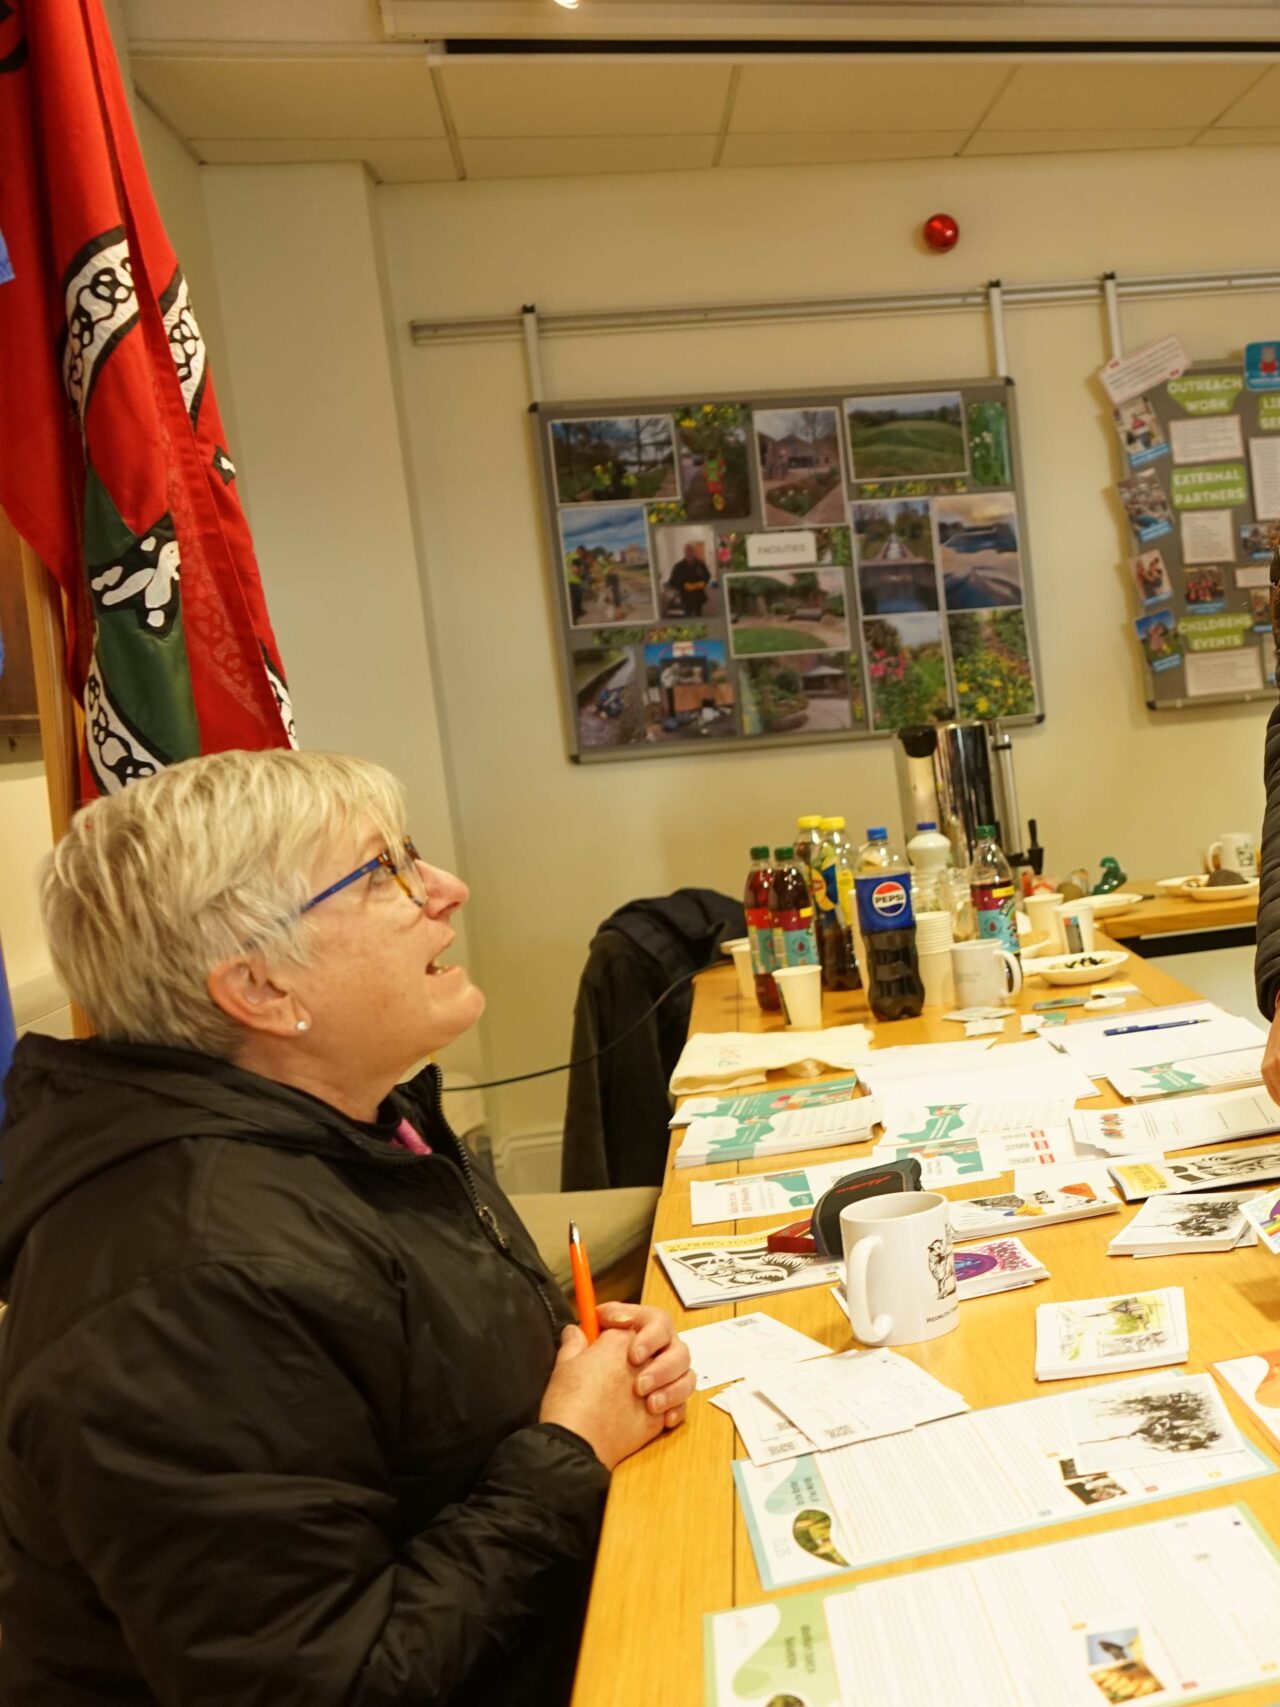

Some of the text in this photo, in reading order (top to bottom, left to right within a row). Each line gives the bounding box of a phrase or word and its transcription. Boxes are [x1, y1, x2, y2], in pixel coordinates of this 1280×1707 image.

[1167, 377, 1243, 395] OUTREACH
[1185, 398, 1229, 413] WORK
[1173, 468, 1241, 487] EXTERNAL
[1173, 487, 1245, 506] PARTNERS
[1192, 633, 1241, 651] EVENTS
[874, 893, 904, 904] PEPSI
